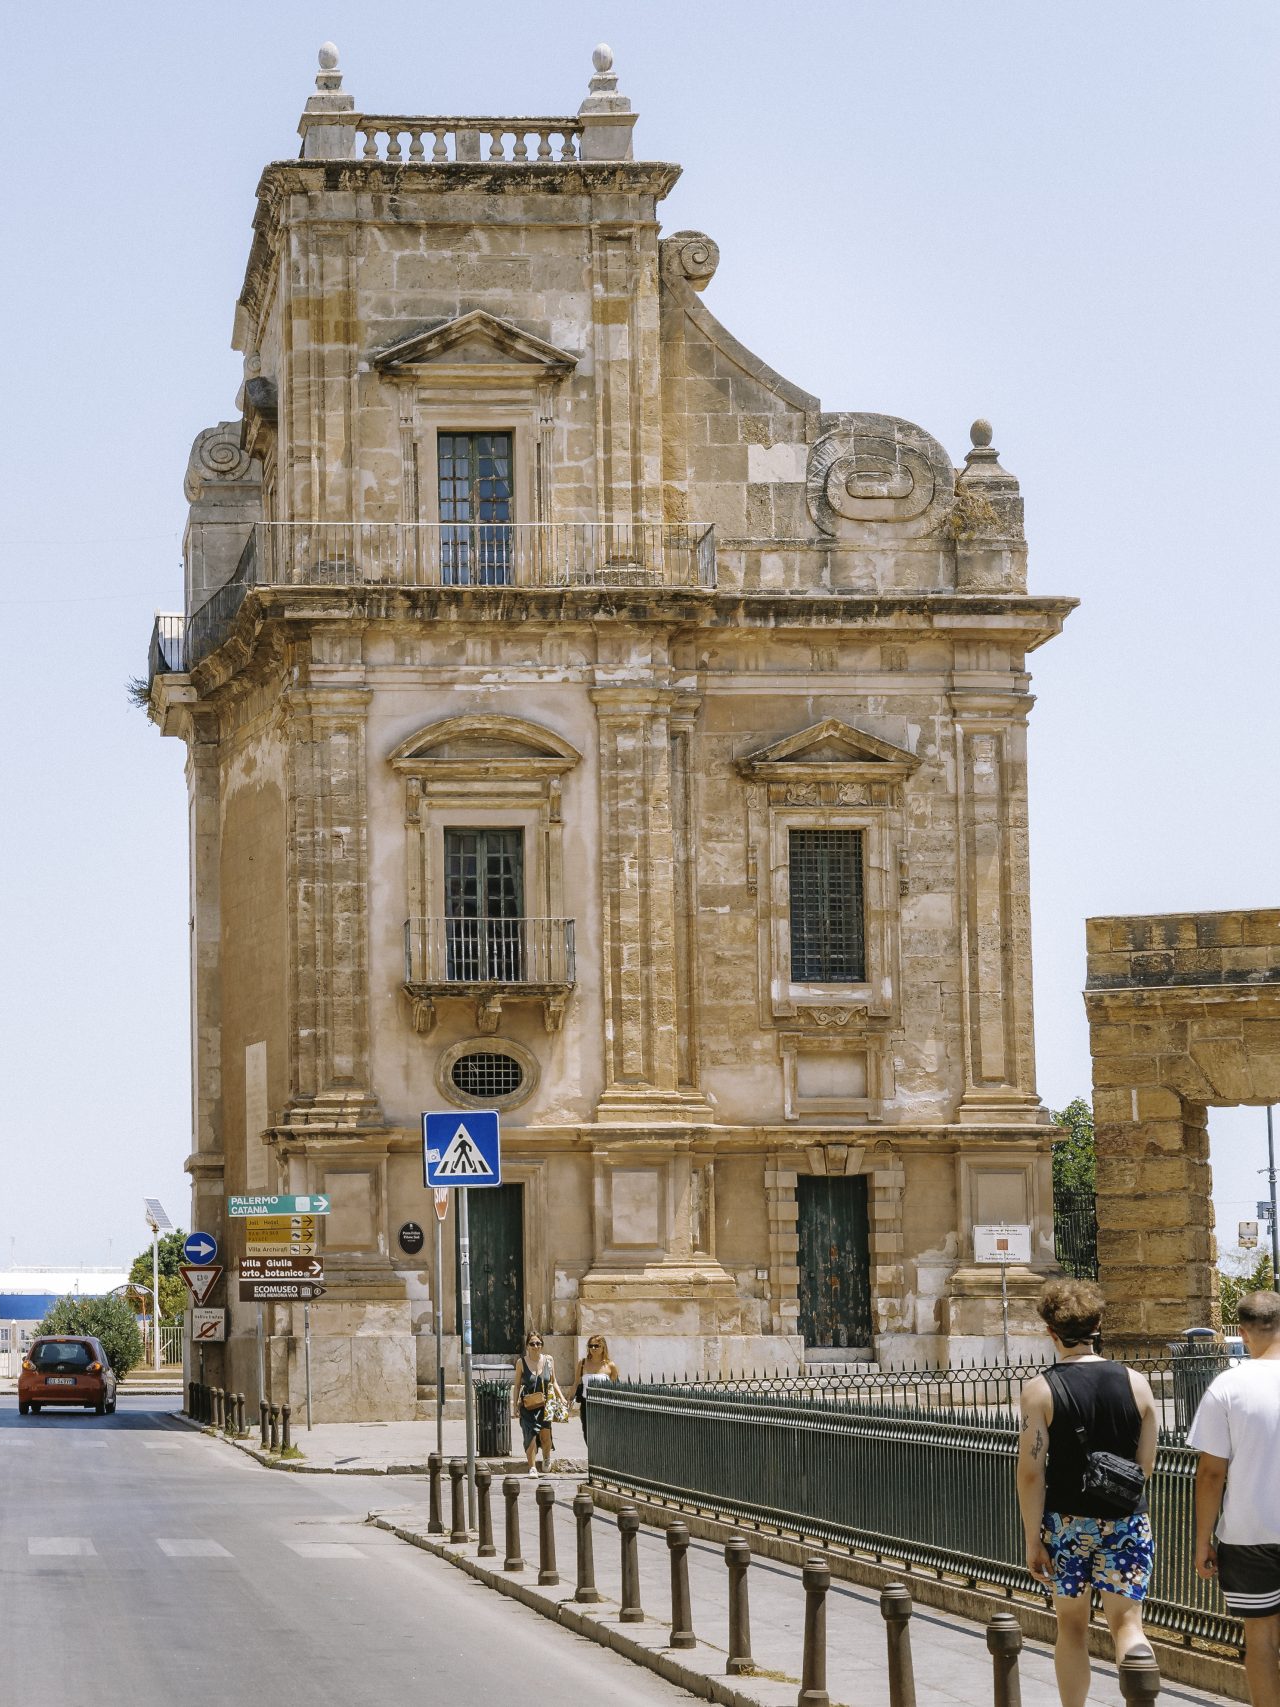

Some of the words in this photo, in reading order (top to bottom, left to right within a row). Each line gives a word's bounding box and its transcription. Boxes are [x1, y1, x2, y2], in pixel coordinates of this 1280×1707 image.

[231, 1196, 279, 1205] PALERMO
[231, 1206, 269, 1215] CATANIA
[241, 1259, 261, 1267] villa
[266, 1259, 293, 1267] Giulia
[241, 1269, 260, 1277] orto
[265, 1269, 303, 1277] botanico
[253, 1285, 298, 1293] ECOMUSEO
